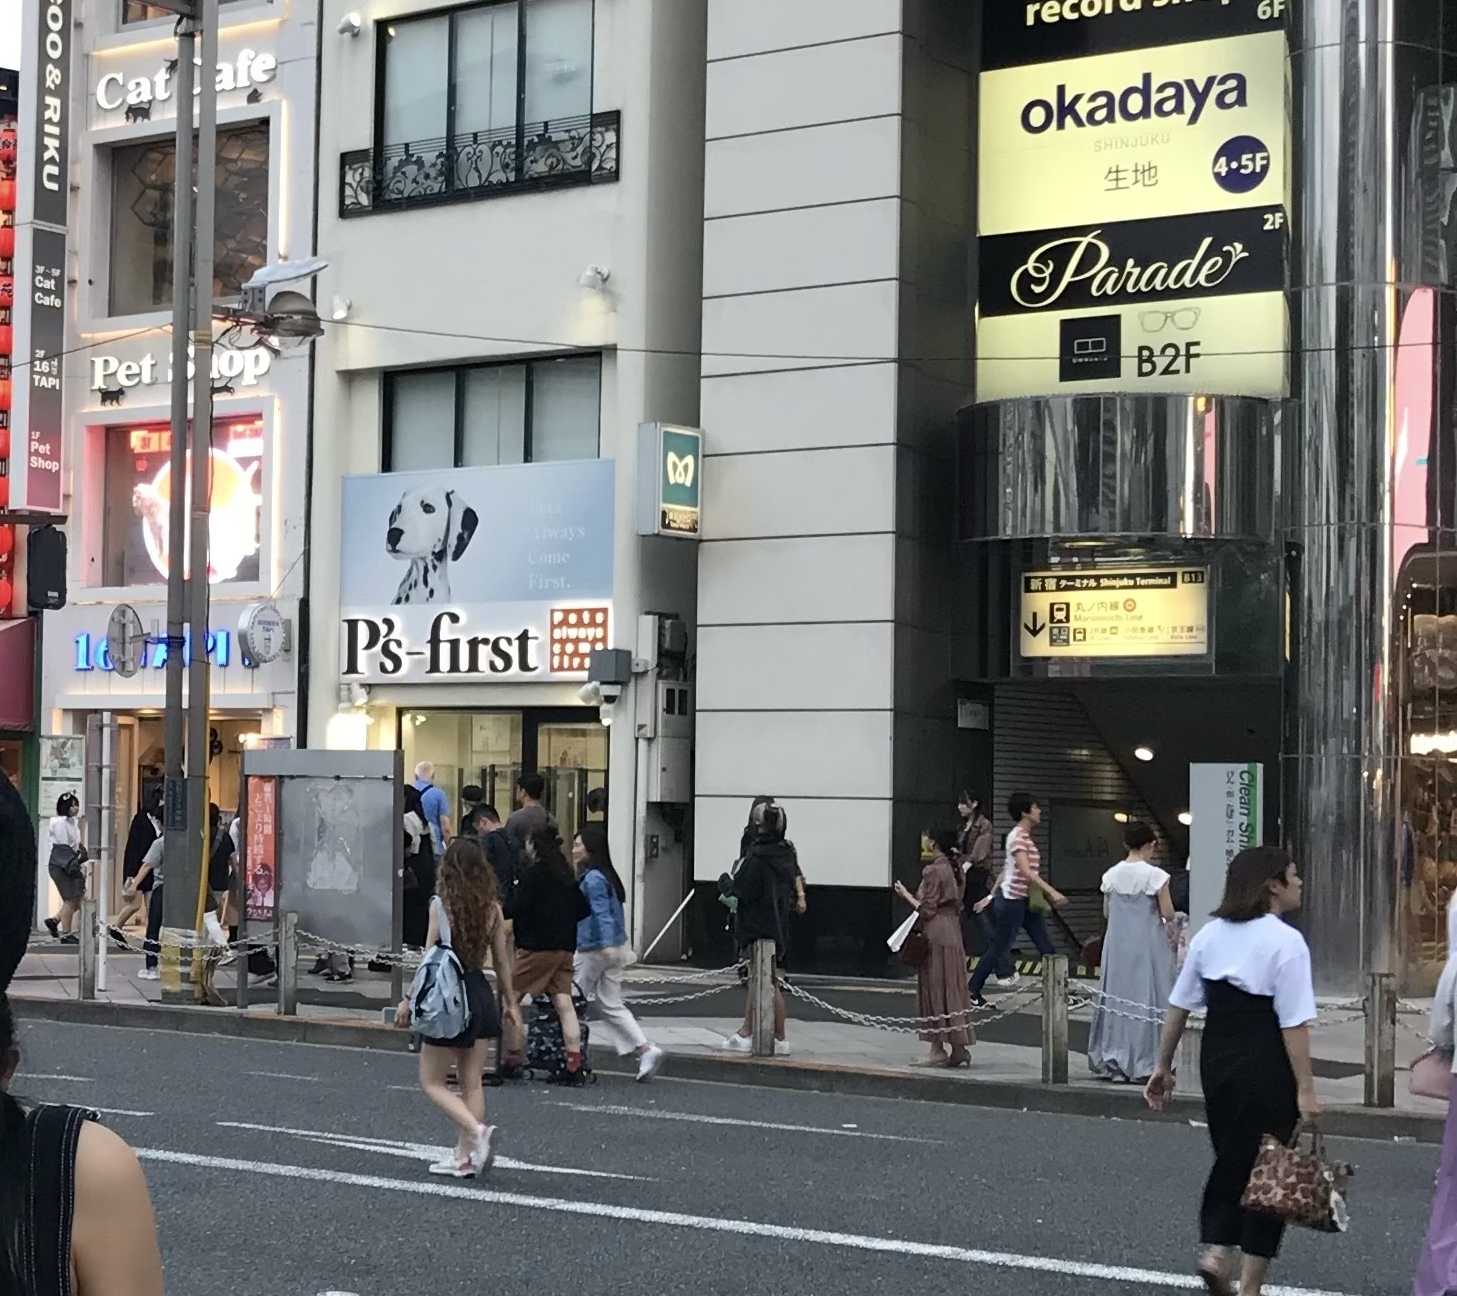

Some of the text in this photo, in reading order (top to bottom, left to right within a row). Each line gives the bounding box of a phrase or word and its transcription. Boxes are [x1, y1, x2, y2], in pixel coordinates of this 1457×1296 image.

[44, 63, 62, 90] &
[96, 66, 172, 110] Cat
[1020, 72, 1248, 135] okadaya
[42, 96, 61, 192] RIKU
[1093, 132, 1171, 153] SHINJUKU
[1103, 161, 1159, 192] 生地
[1263, 212, 1284, 231] 2F
[1010, 229, 1249, 308] Parade
[34, 276, 56, 291] Cat
[34, 292, 62, 308] Cafe
[33, 360, 50, 374] 16
[90, 351, 158, 390] Pet
[1136, 341, 1202, 378] B2F
[32, 375, 60, 390] TAPI
[30, 441, 51, 455] Pet
[29, 456, 60, 473] Shop
[1029, 577, 1057, 591] 新宿
[1100, 577, 1135, 589] Shinjuku
[1136, 576, 1171, 586] Terminal
[1183, 572, 1203, 583] B13
[341, 611, 539, 676] P's-first
[1239, 769, 1255, 817] Clean
